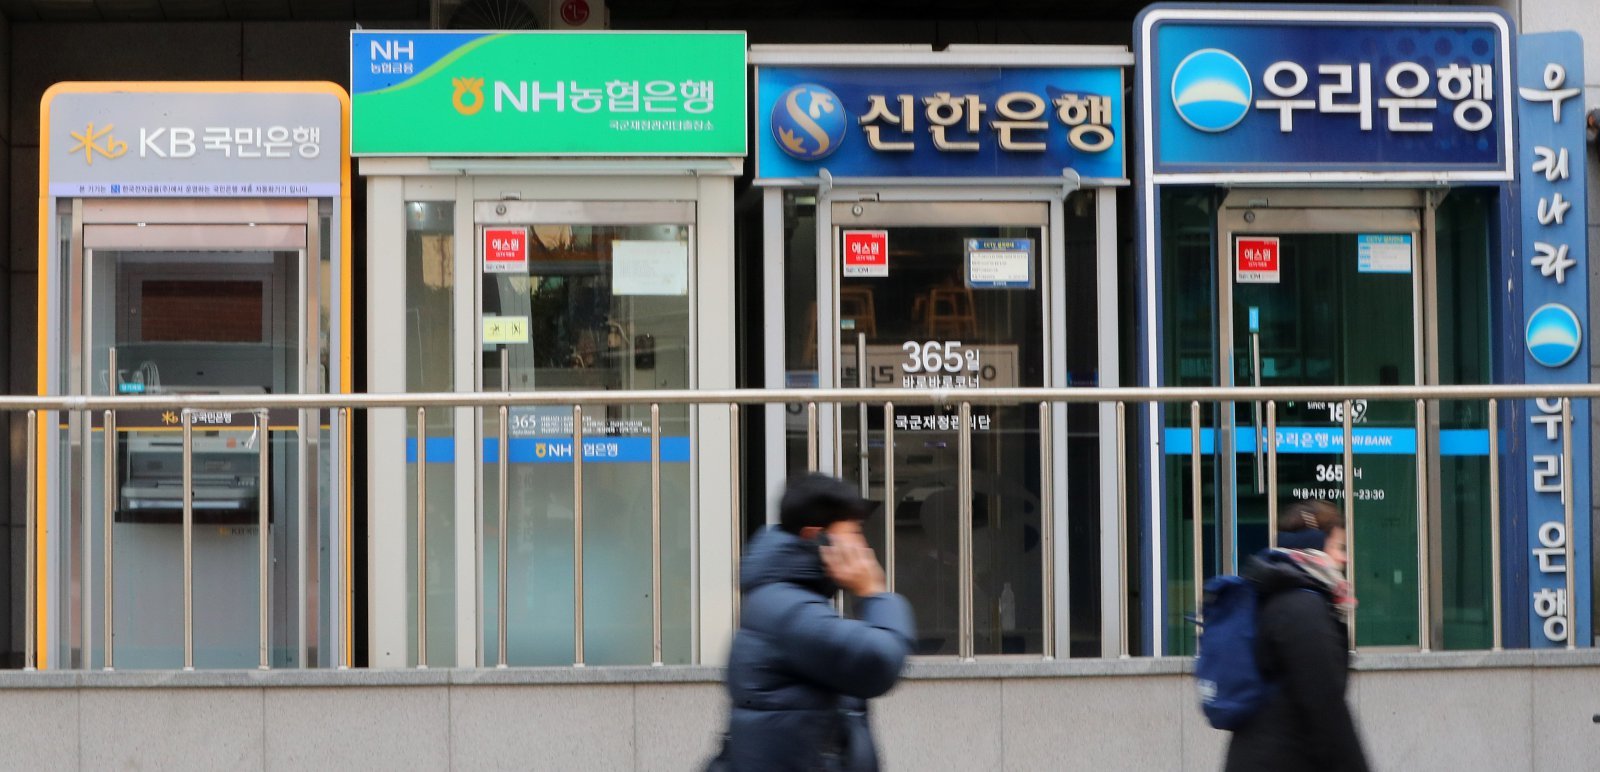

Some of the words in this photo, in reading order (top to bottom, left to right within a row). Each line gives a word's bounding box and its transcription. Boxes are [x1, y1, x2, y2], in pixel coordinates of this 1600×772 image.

[370, 40, 414, 60] NH
[494, 79, 715, 115] NH농협은행
[1255, 60, 1493, 133] 우리은행
[857, 91, 1116, 152] 신한은행
[1518, 62, 1581, 284] 우리나라
[902, 340, 980, 373] 365일
[511, 414, 536, 429] 365
[548, 442, 618, 457] NH협은행
[1364, 435, 1393, 446] BANK
[1292, 488, 1327, 500] 이용시간
